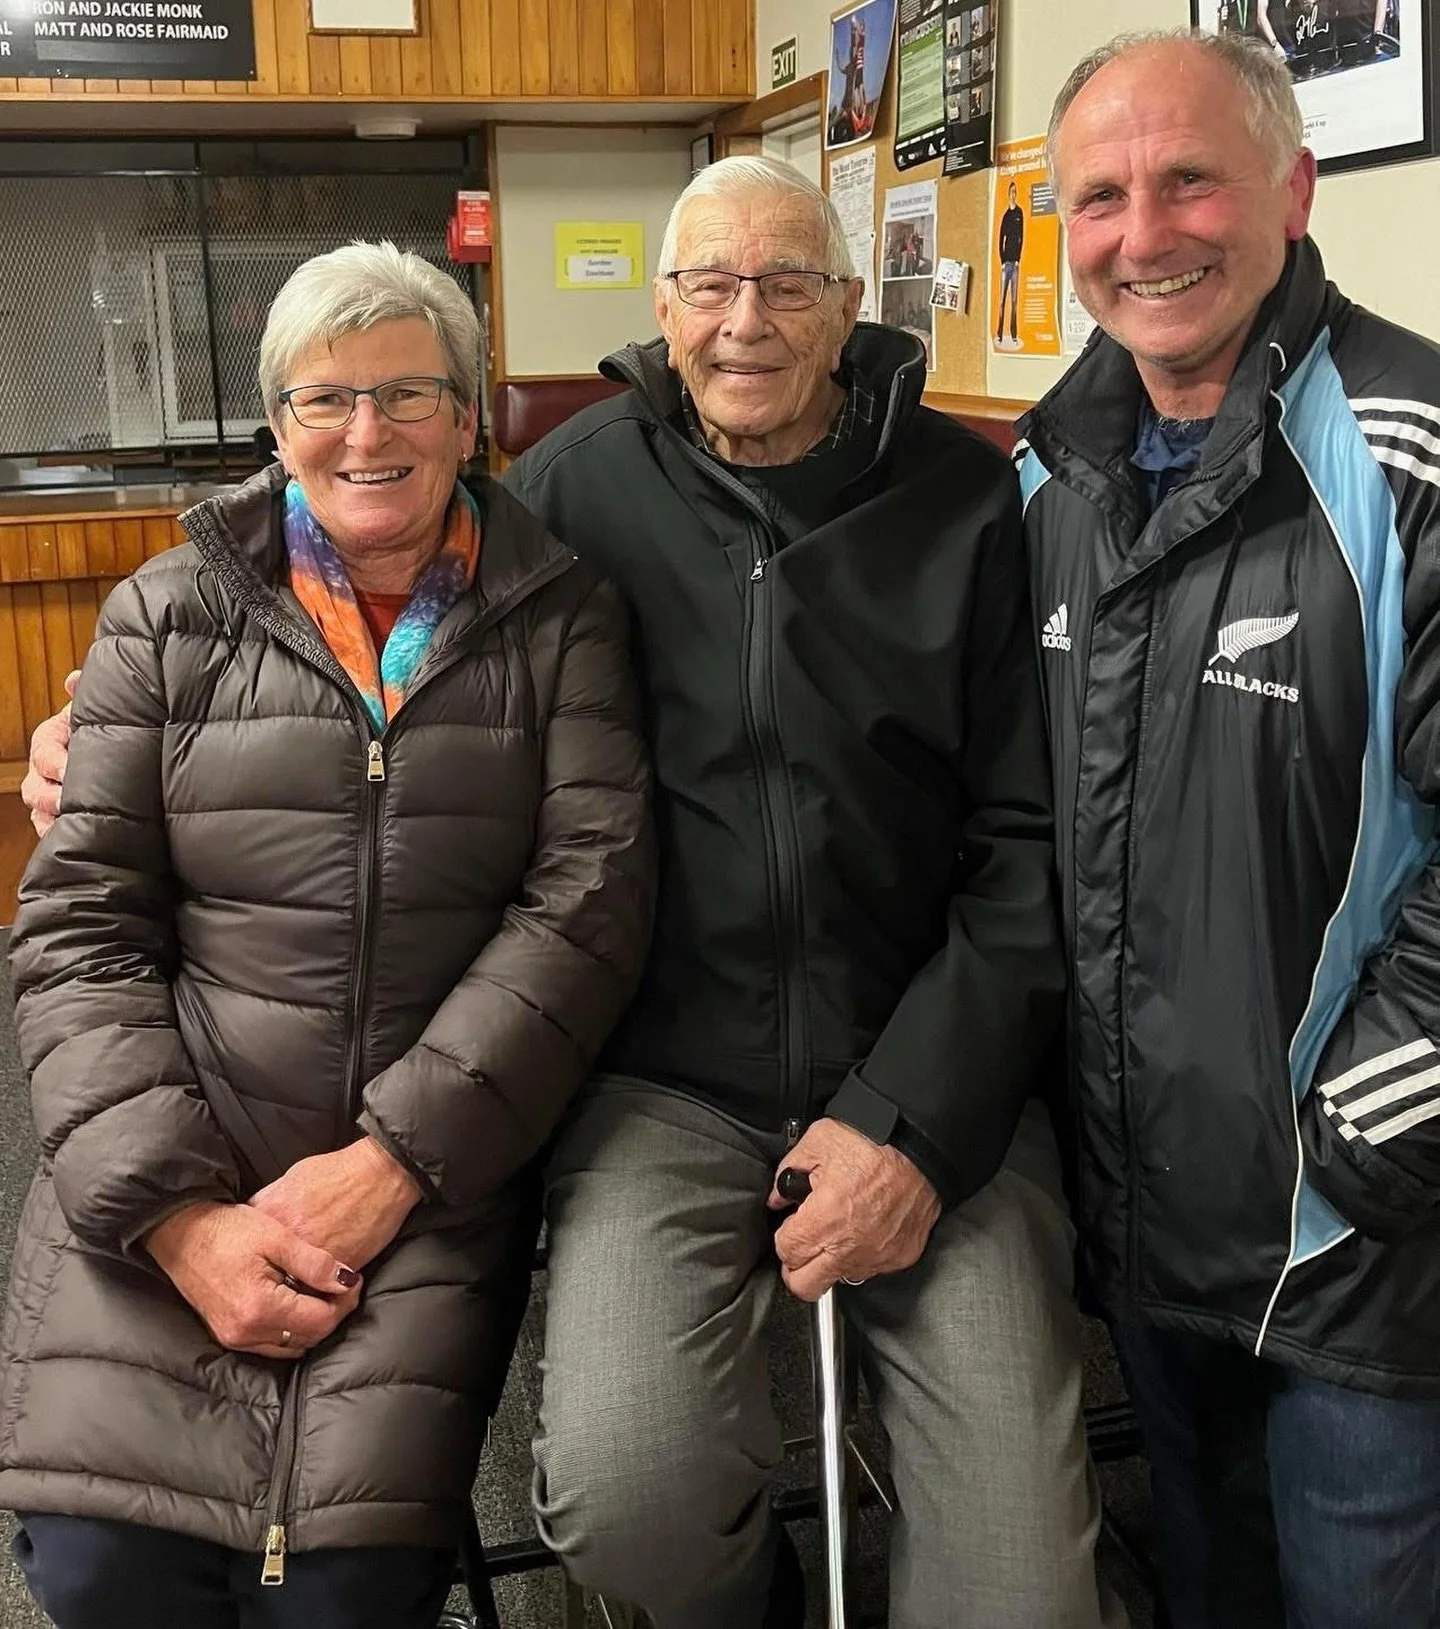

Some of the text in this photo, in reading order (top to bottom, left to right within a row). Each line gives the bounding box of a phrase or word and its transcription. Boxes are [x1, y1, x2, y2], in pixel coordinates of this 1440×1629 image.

[34, 0, 203, 18] RON AND JACKIE MONK
[34, 21, 229, 40] MATT AND ROSE FAIRMAID
[773, 46, 796, 81] EXIT
[1202, 669, 1233, 687] ALL
